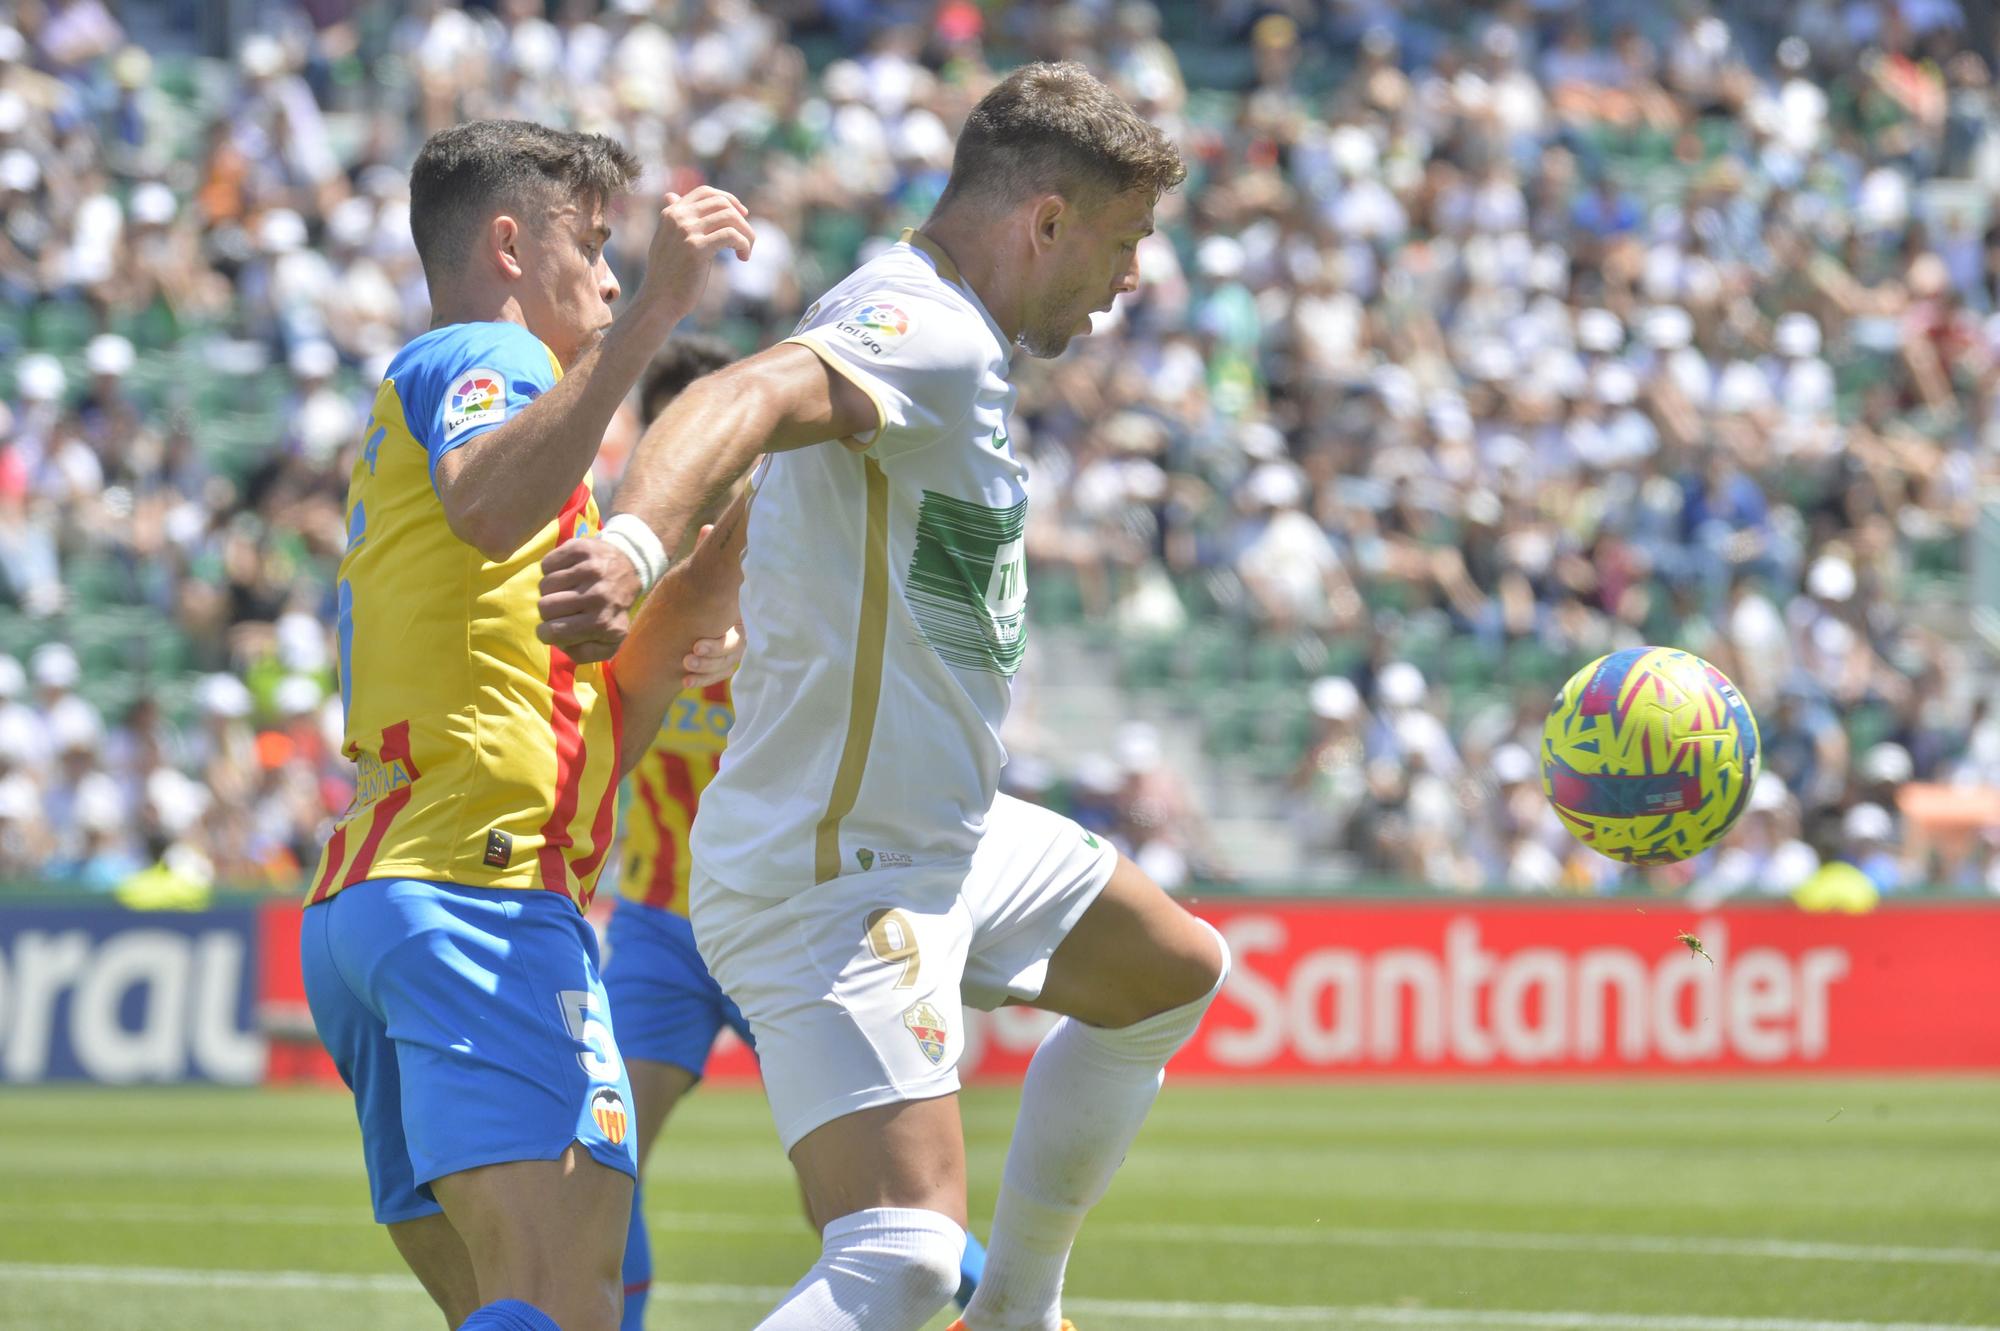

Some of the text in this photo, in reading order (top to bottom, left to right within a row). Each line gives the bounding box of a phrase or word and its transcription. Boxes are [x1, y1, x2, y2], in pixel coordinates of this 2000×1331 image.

[836, 321, 882, 355] LaLiga
[878, 852, 913, 862] ELCHE
[863, 908, 920, 990] 9
[1206, 914, 1850, 1066] Santander
[556, 990, 621, 1083] 5
